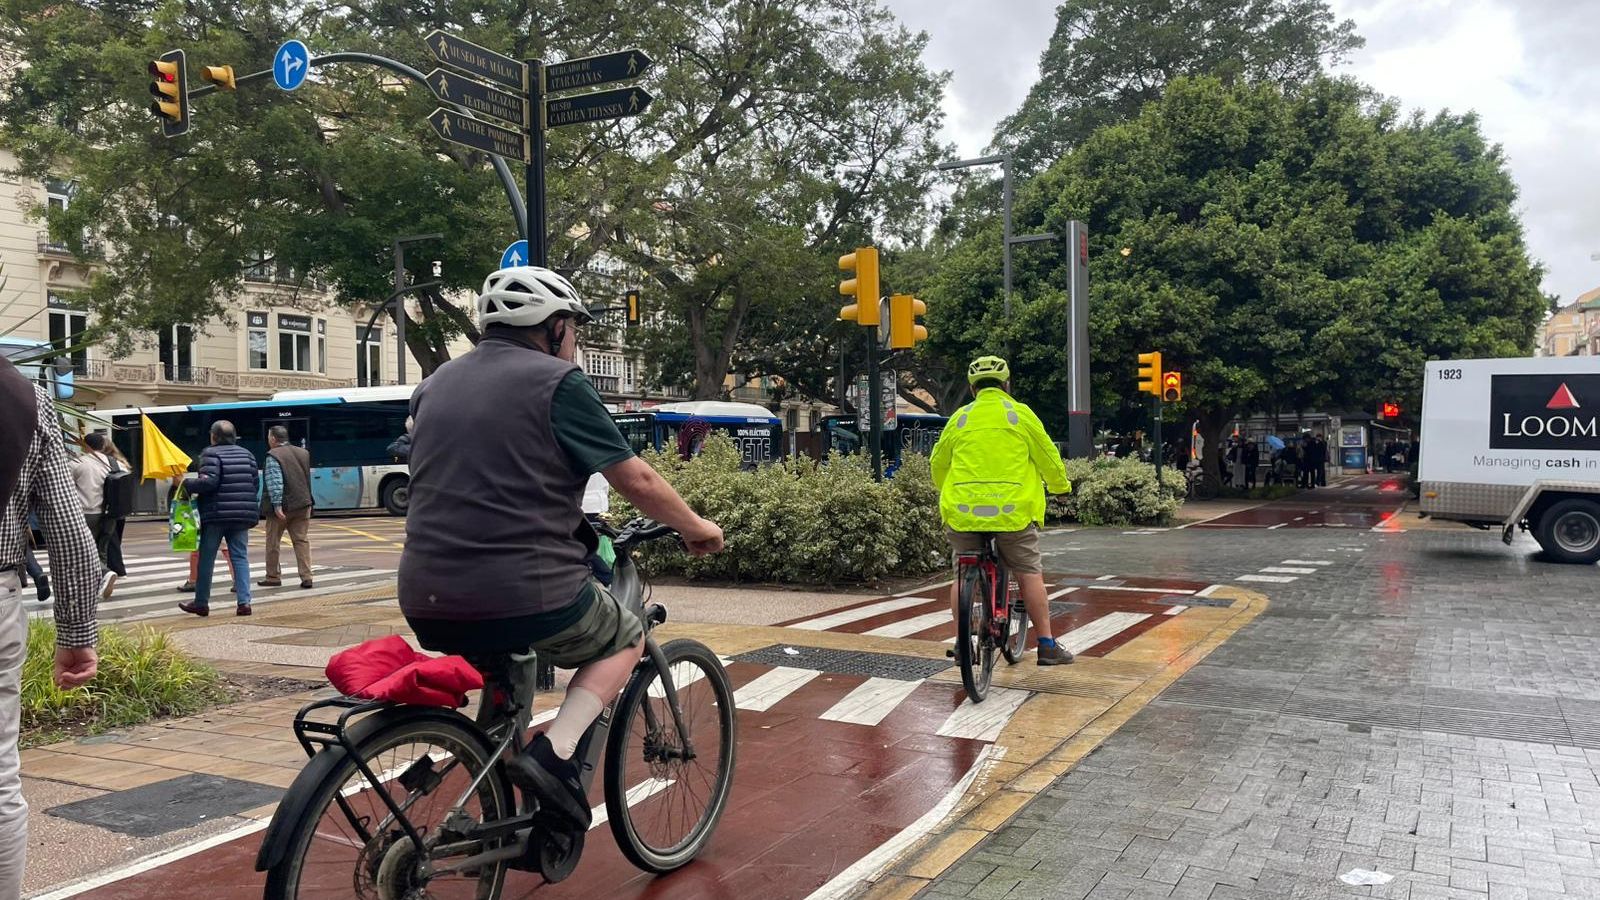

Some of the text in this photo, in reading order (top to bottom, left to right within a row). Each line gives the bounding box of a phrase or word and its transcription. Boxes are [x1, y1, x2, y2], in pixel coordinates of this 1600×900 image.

[449, 45, 475, 65] MUSEO
[476, 55, 487, 69] DE
[551, 70, 602, 90] ATARAZANAS
[463, 94, 521, 121] TEATRO ROMANO
[550, 102, 571, 112] MUSEO
[550, 103, 624, 125] CARMEN THYSSEN
[457, 117, 486, 136] CENTRE
[1438, 369, 1462, 380] 1923
[737, 428, 749, 437] 100%
[1503, 413, 1597, 437] LOOM
[1473, 456, 1597, 470] Managing cash in
